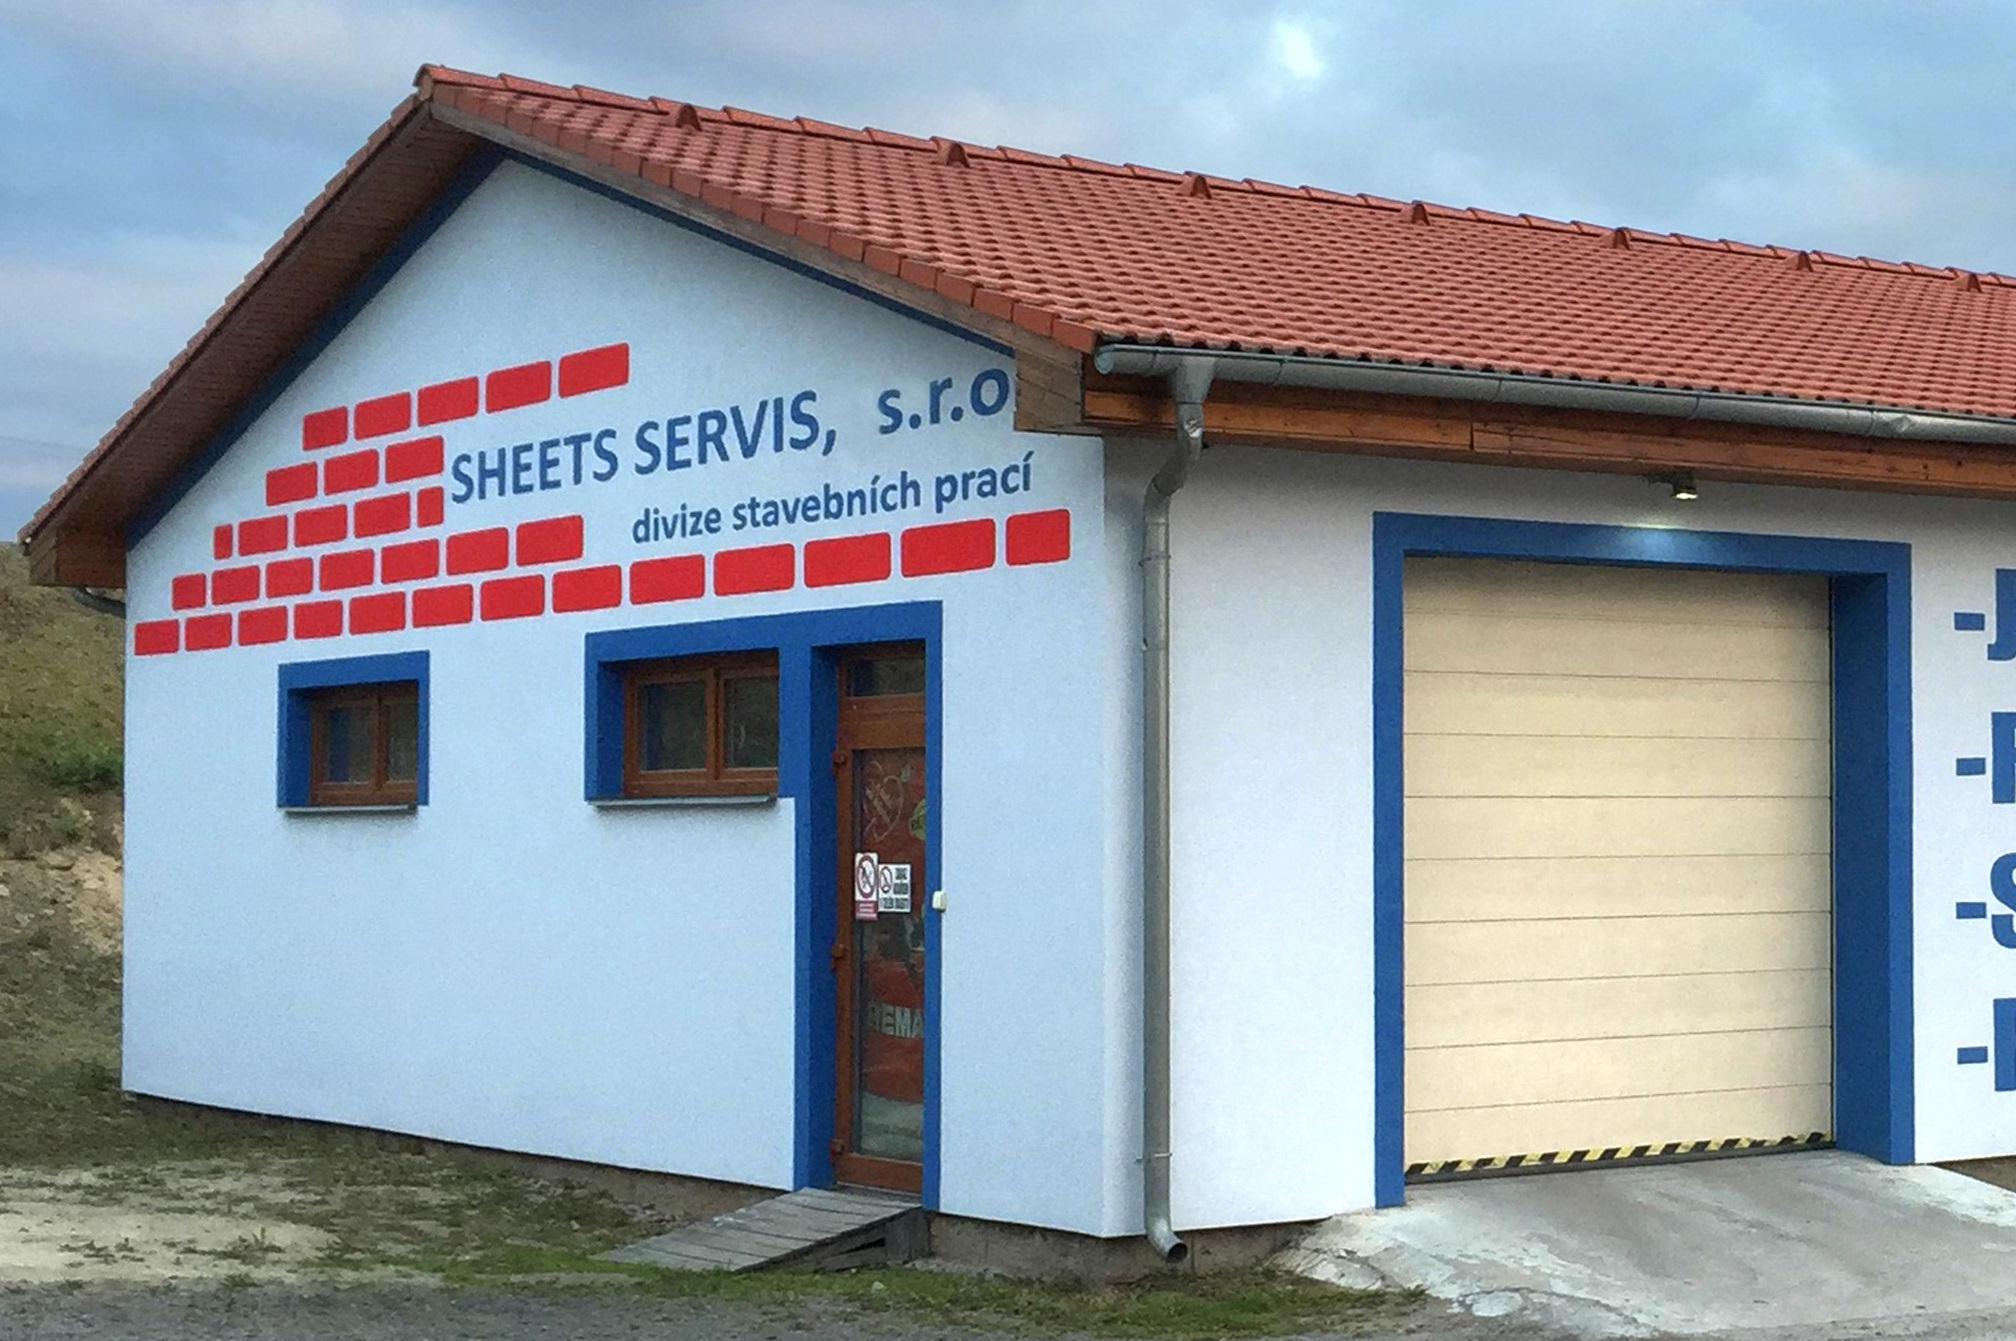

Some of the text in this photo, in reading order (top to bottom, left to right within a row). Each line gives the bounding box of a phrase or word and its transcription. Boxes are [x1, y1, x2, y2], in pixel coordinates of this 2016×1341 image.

[450, 428, 619, 504] SHEETS
[634, 390, 836, 477] SERVIS,
[632, 450, 1034, 544] divize stavebních prací
